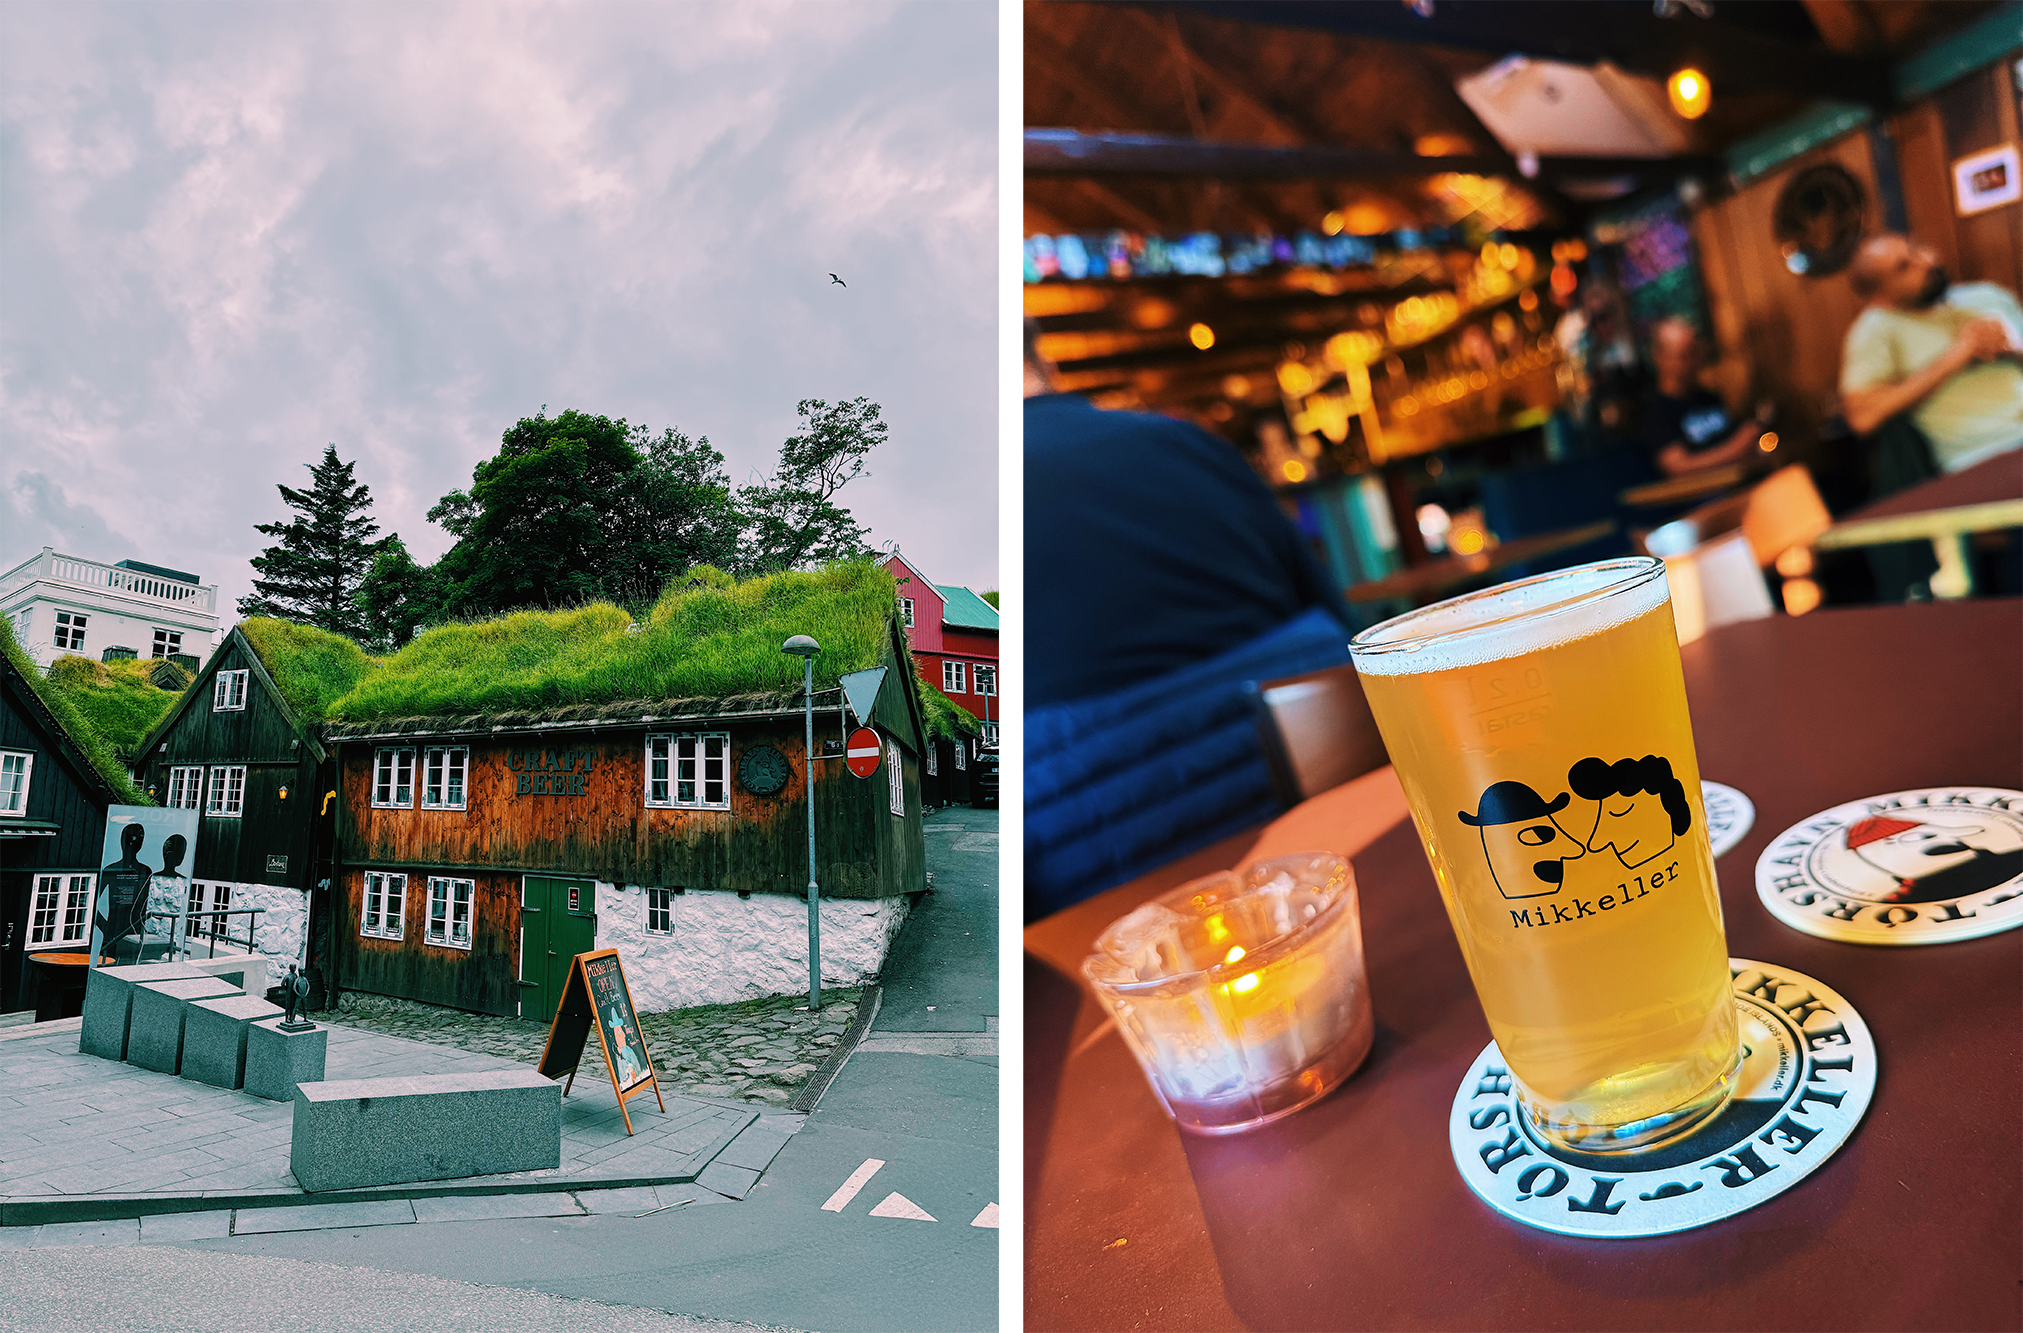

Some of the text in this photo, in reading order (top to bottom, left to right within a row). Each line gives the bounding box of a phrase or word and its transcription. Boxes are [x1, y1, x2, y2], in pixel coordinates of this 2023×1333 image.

[507, 750, 598, 771] CRAFT
[515, 774, 586, 795] BEER
[1510, 861, 1680, 928] Mikkeller
[587, 960, 618, 978] Mikkeller
[597, 976, 616, 993] OPEN
